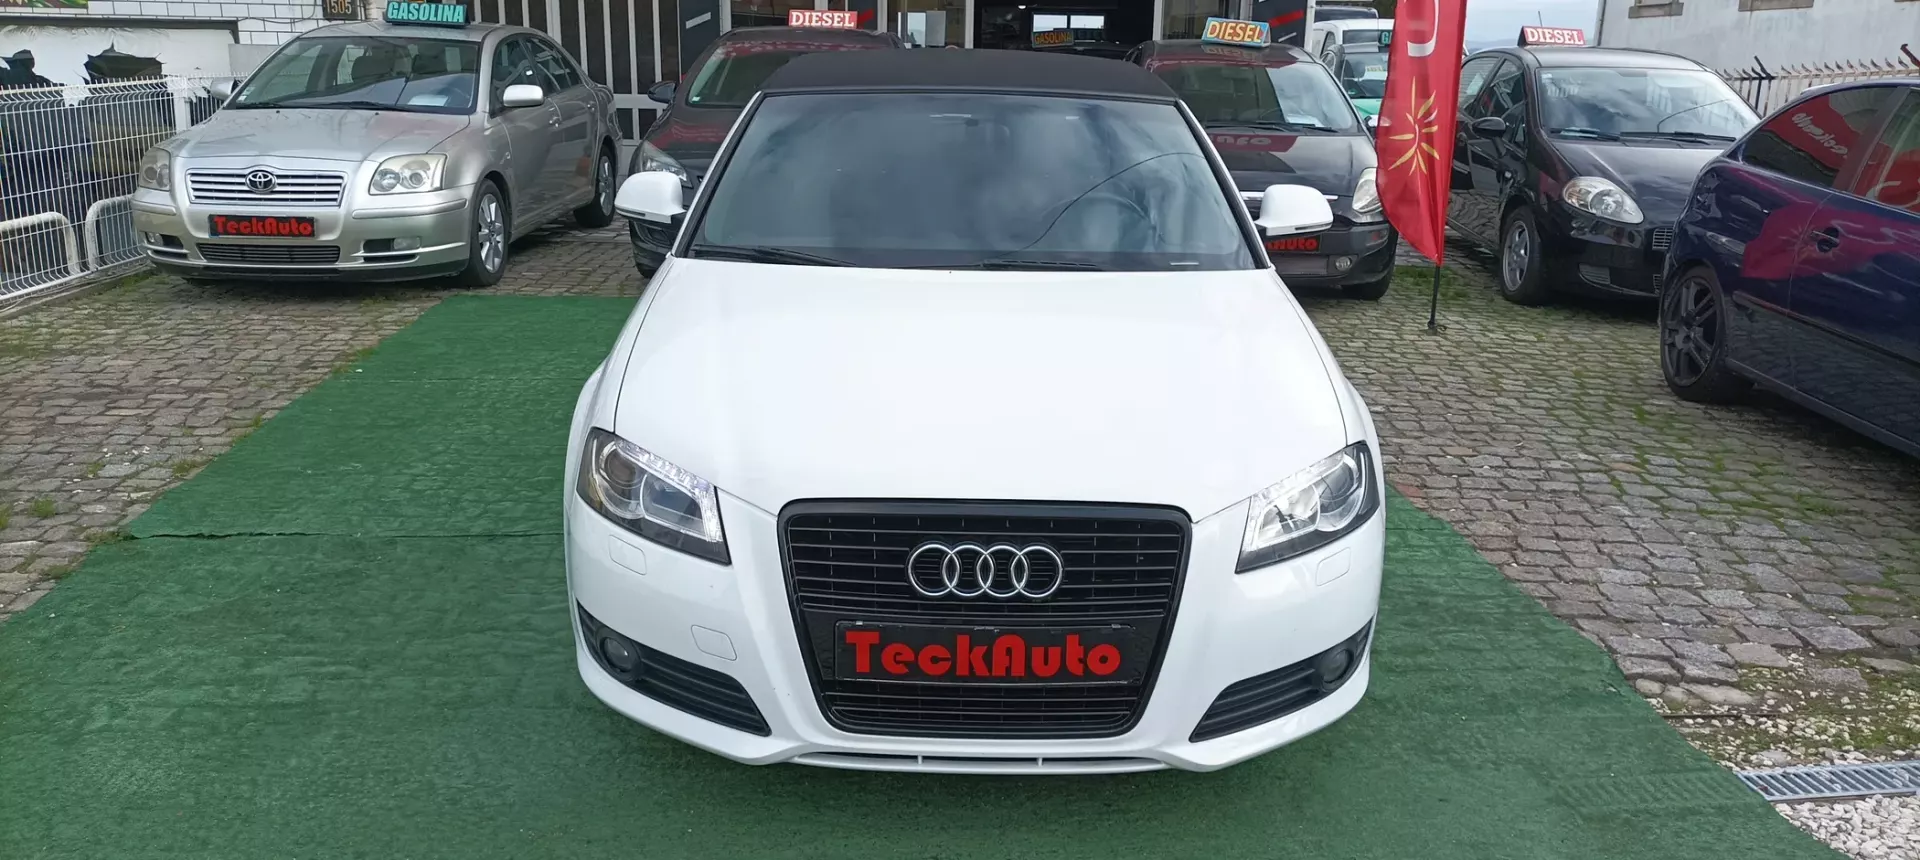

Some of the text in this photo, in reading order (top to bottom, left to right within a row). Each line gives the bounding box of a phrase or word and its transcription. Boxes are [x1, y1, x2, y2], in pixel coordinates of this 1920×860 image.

[325, 0, 351, 13] 1505
[387, 2, 465, 22] GASOLINA
[791, 12, 854, 27] DIESEL
[1035, 32, 1072, 45] GASOLINA
[1206, 21, 1261, 42] DIESEL
[1525, 27, 1584, 44] DIESEL
[213, 215, 312, 235] TeckAuto
[845, 631, 1121, 677] TeckAuto
